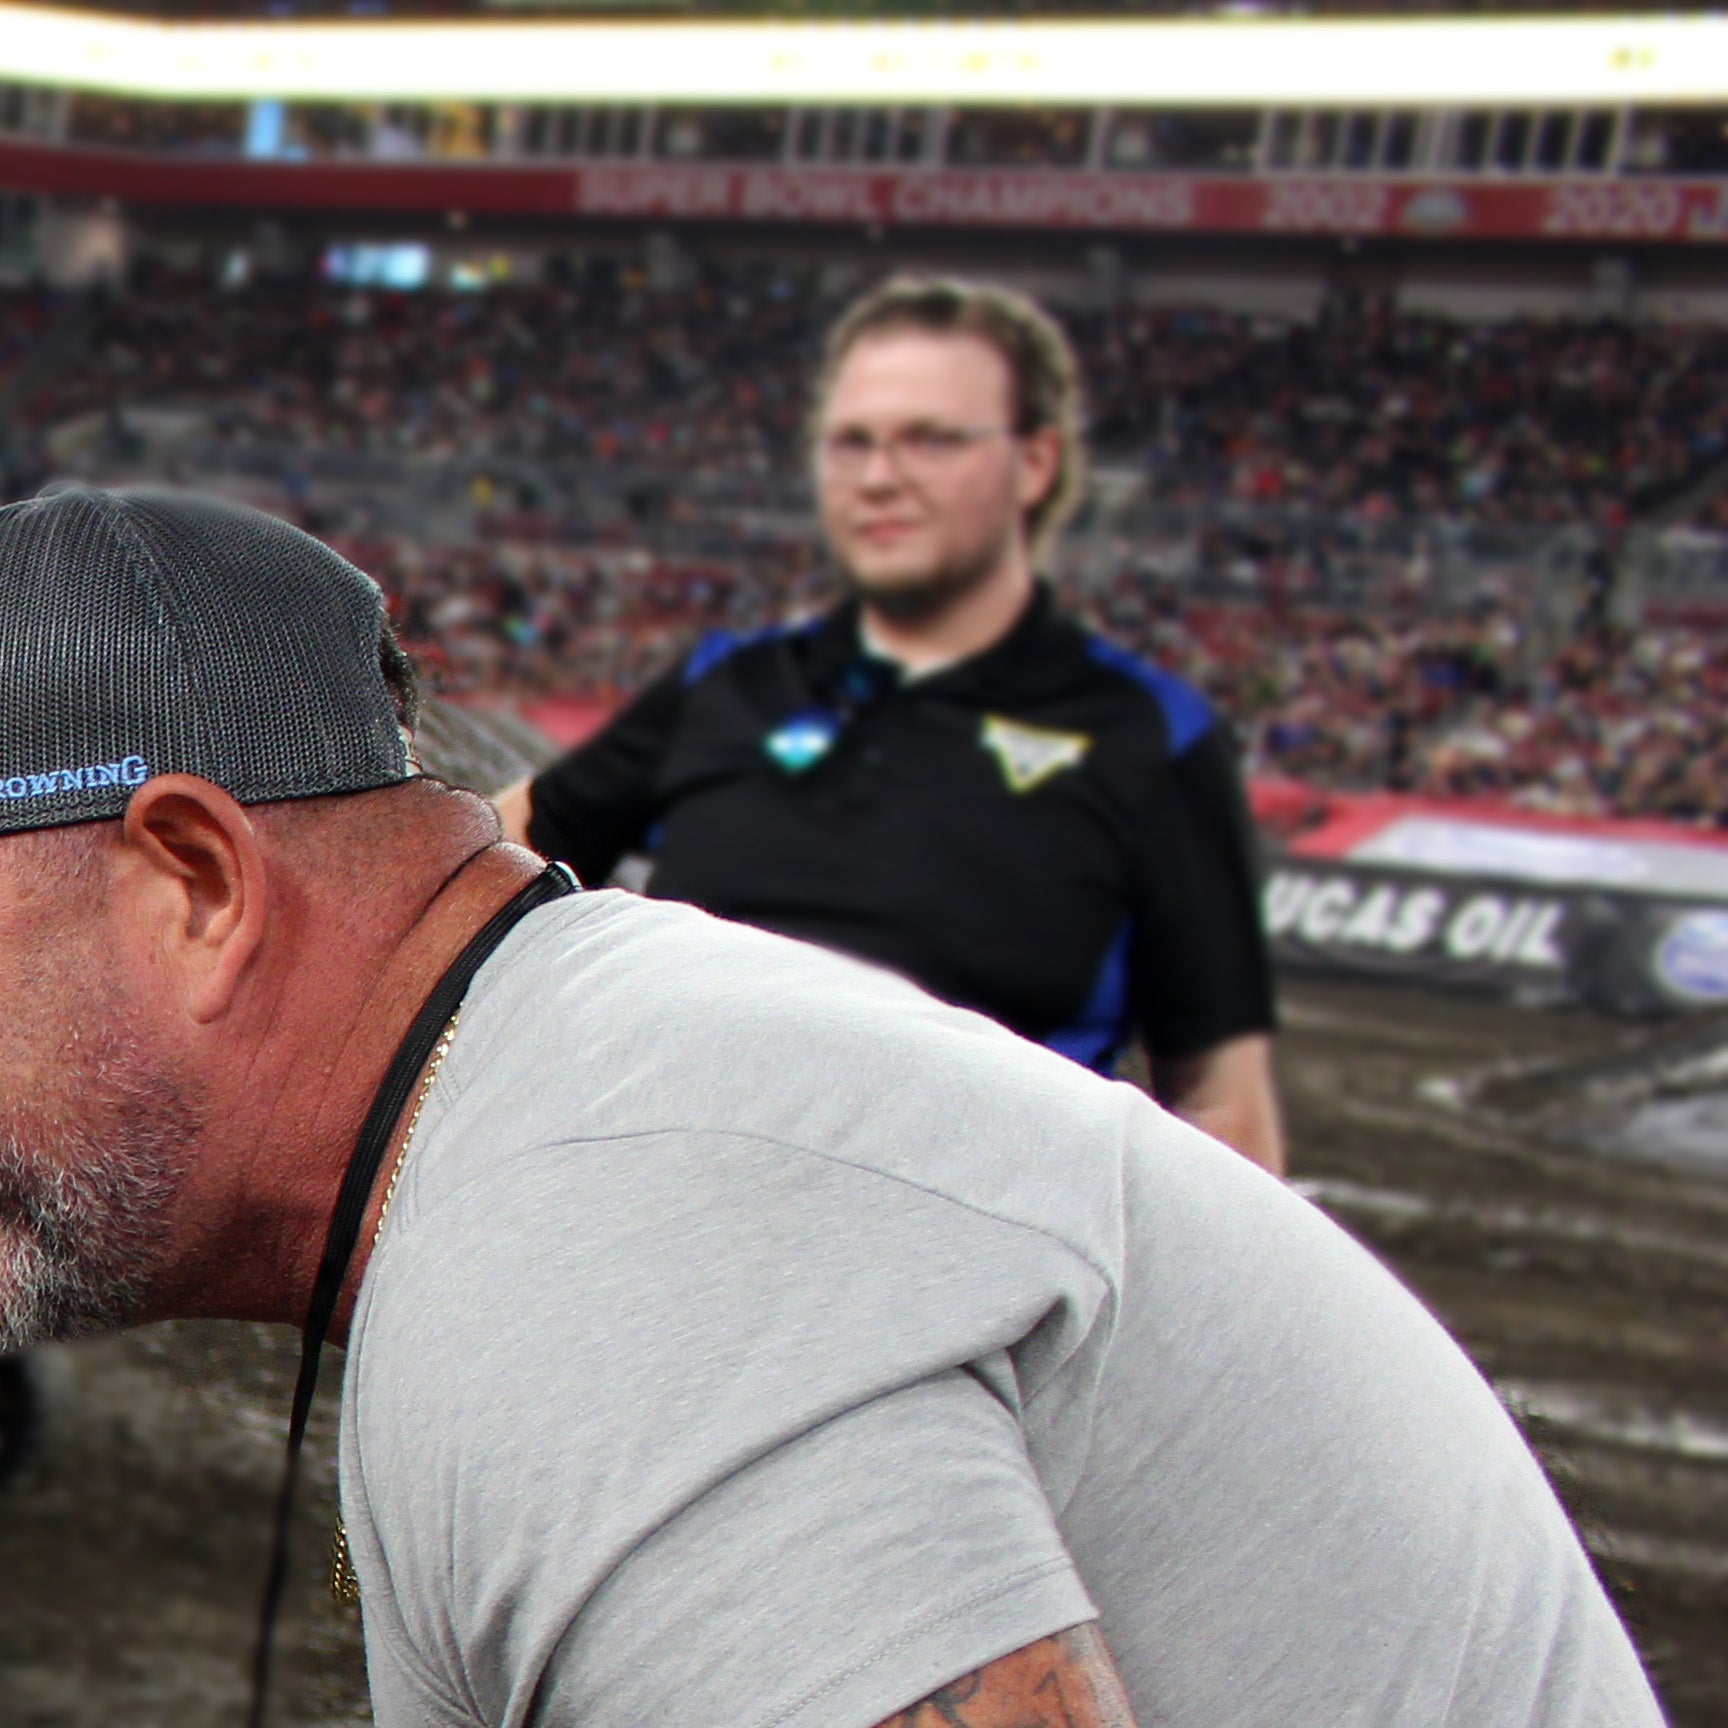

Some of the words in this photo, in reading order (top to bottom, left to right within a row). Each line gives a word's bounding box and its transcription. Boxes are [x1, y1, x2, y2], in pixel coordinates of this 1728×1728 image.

[740, 176, 875, 218] BOWL
[894, 179, 1194, 226] CHAMPIONS
[1542, 187, 1680, 233] 2020
[1260, 876, 1443, 952] UCAS
[1447, 896, 1562, 967] OIL
